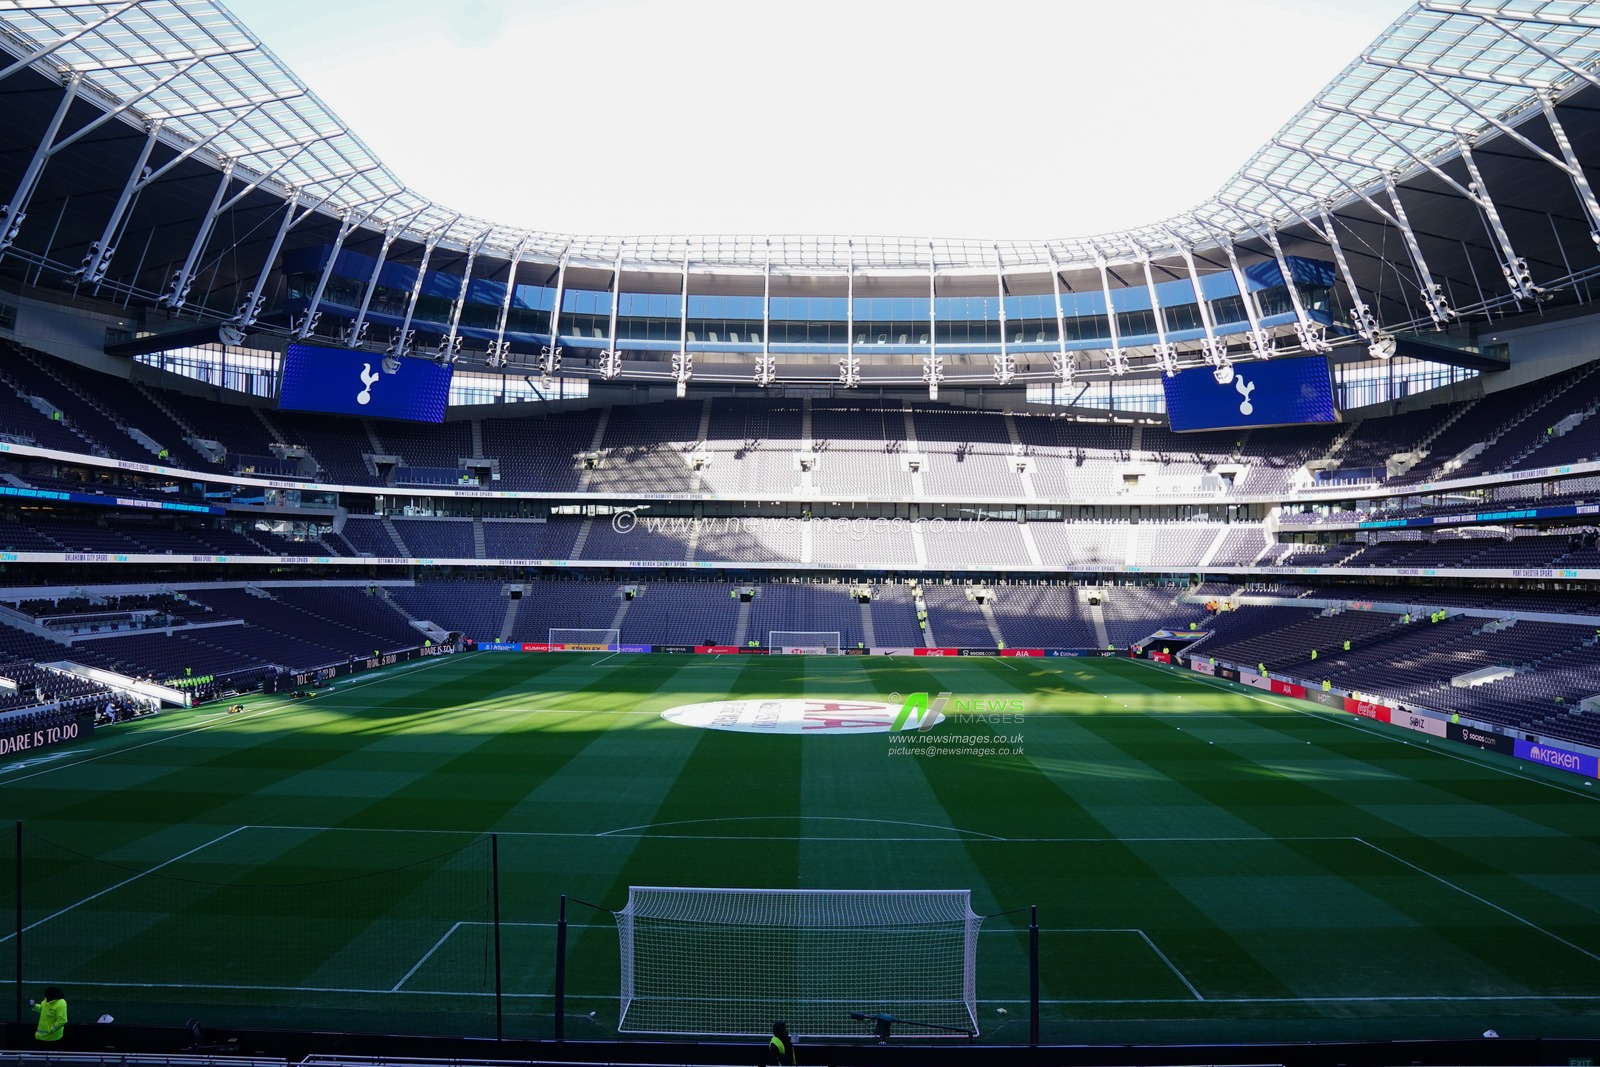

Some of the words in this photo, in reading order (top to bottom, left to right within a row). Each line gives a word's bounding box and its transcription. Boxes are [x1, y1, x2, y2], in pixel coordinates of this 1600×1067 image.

[329, 668, 336, 678] DO
[1283, 685, 1291, 694] AIA
[1358, 702, 1376, 718] Coca-Cola
[0, 733, 31, 755] DARE
[34, 730, 44, 747] IS
[47, 726, 60, 744] TO
[63, 723, 78, 739] DO
[1540, 748, 1580, 770] kraken
